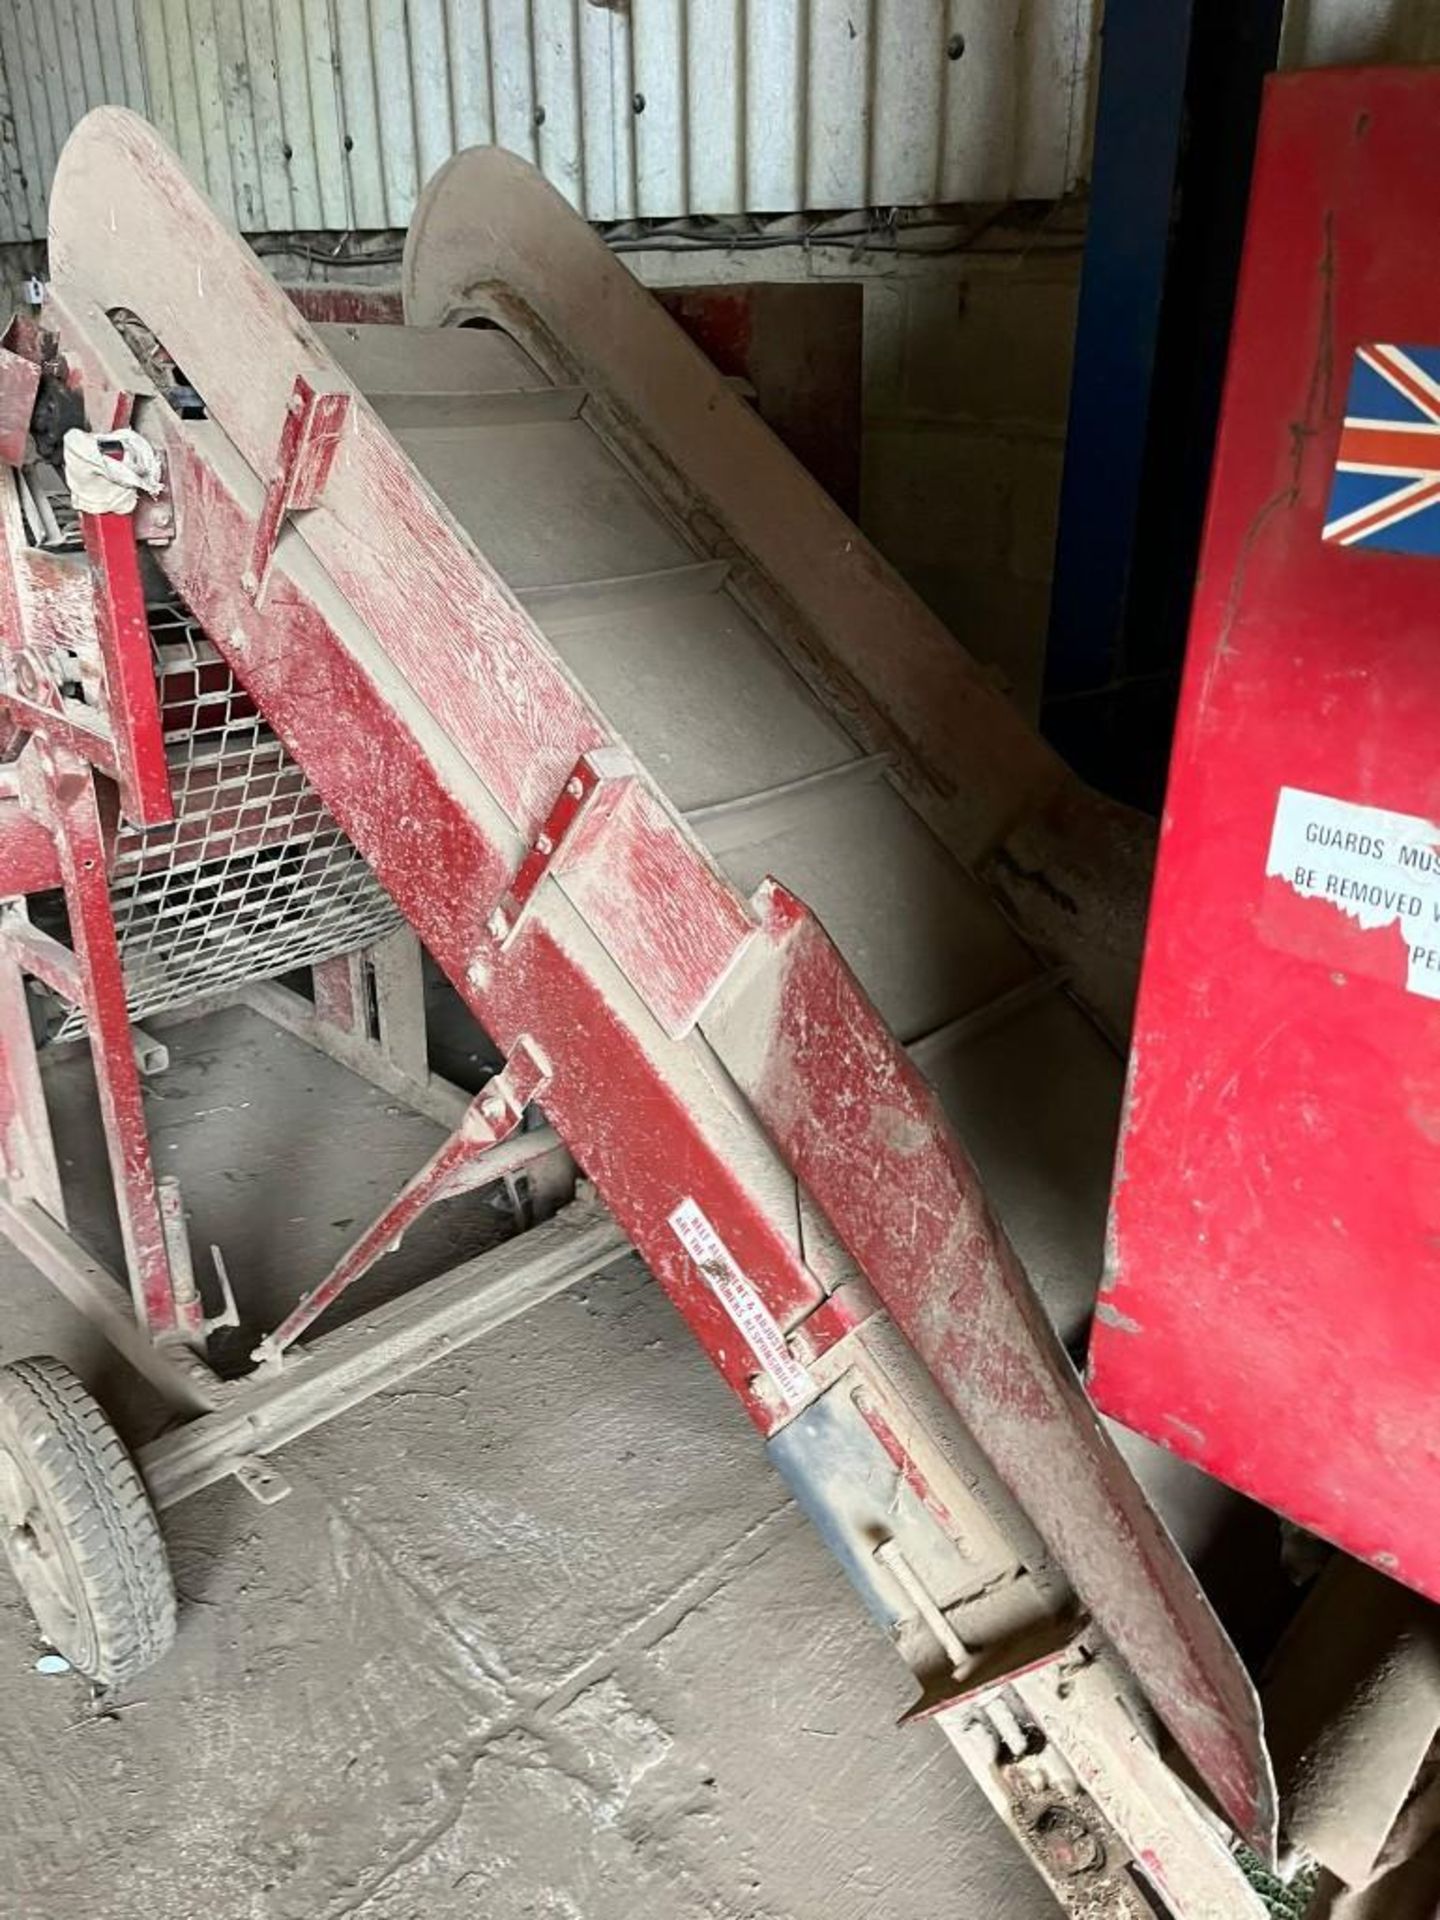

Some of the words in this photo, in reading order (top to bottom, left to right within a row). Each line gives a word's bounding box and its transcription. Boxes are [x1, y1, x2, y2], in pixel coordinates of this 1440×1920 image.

[1305, 822, 1385, 860] GUARDS
[1294, 866, 1318, 888] BE
[1325, 874, 1423, 917] REMOVED
[675, 1216, 691, 1235] ARE
[690, 1237, 705, 1256] THE
[703, 1257, 744, 1318] CTOMERS
